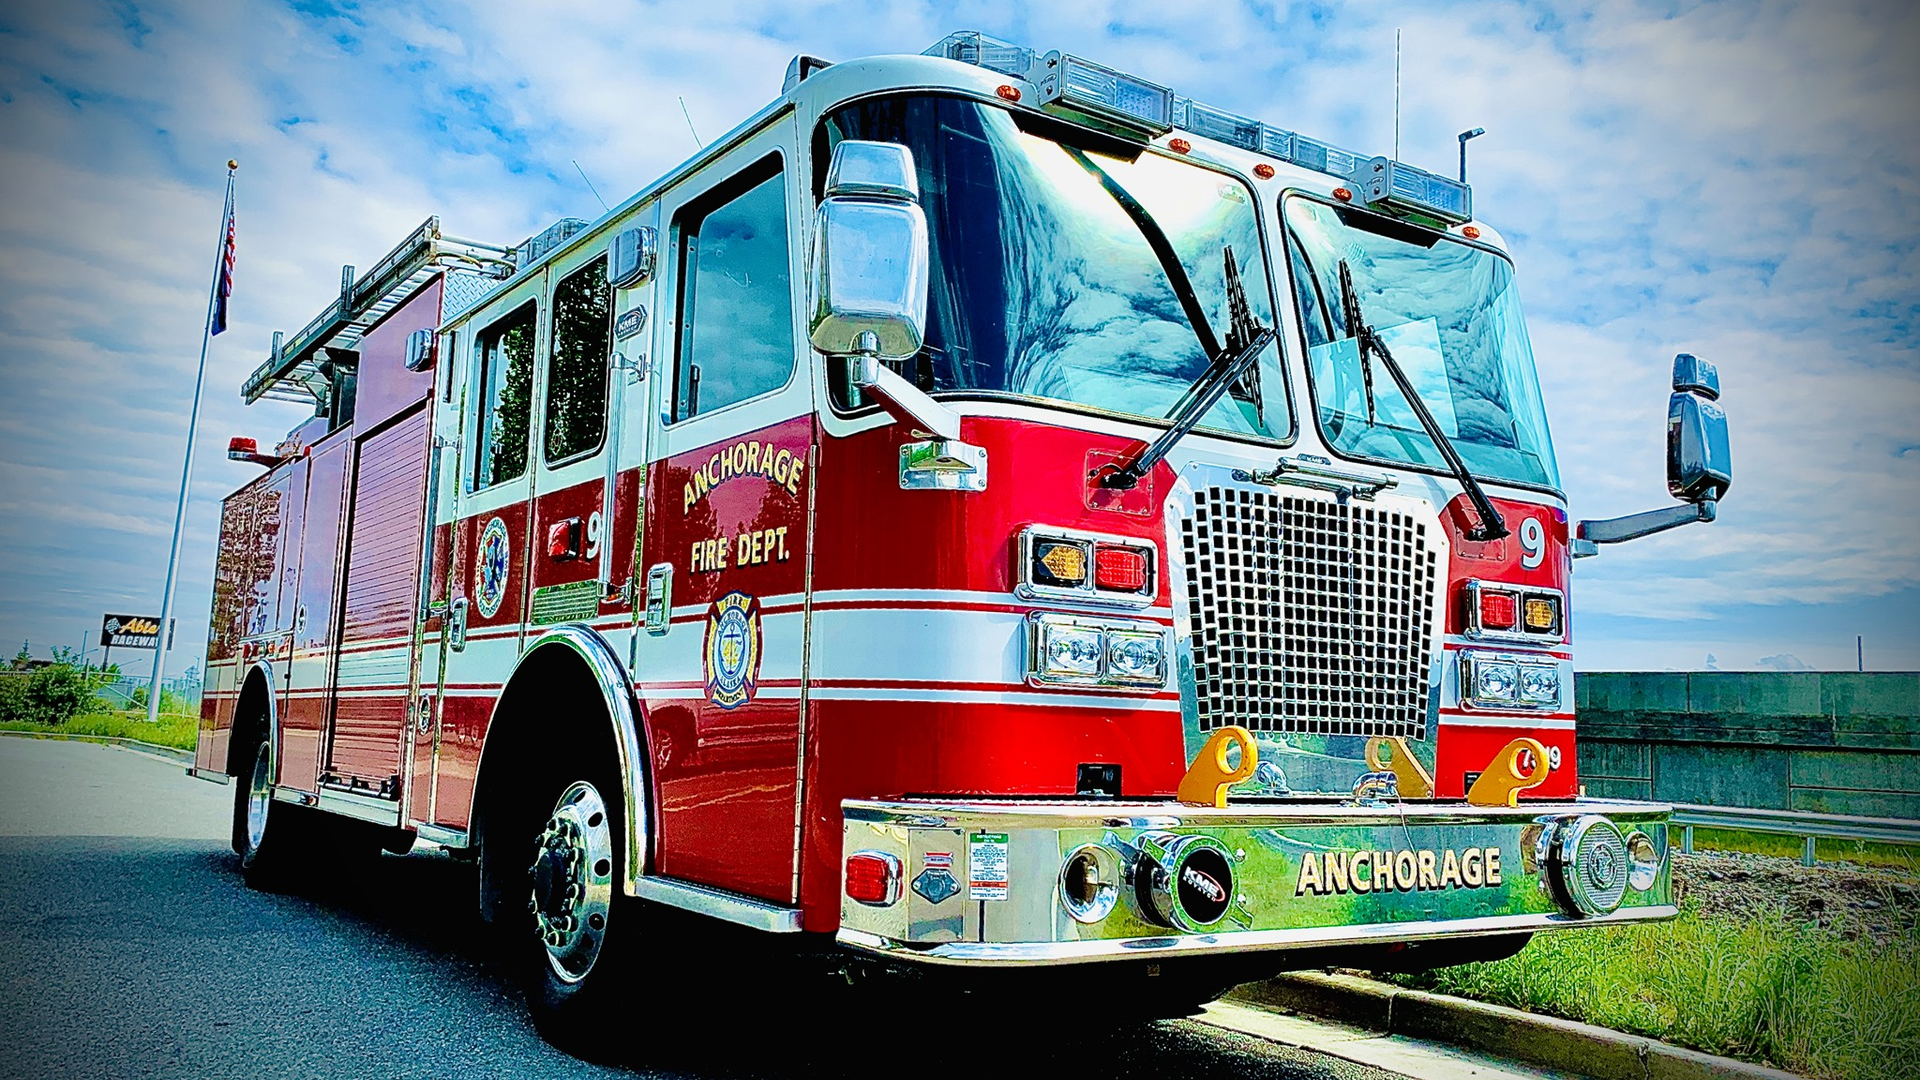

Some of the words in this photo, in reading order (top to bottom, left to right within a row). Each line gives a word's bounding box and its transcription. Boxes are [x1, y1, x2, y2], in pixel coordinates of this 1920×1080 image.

[684, 441, 804, 515] ANCHORAGE
[586, 511, 601, 559] 9
[690, 537, 728, 573] FIRE
[737, 526, 790, 567] DEPT.
[1519, 516, 1545, 570] 9
[1184, 866, 1220, 898] KME
[1296, 848, 1502, 896] ANCHORAGE
